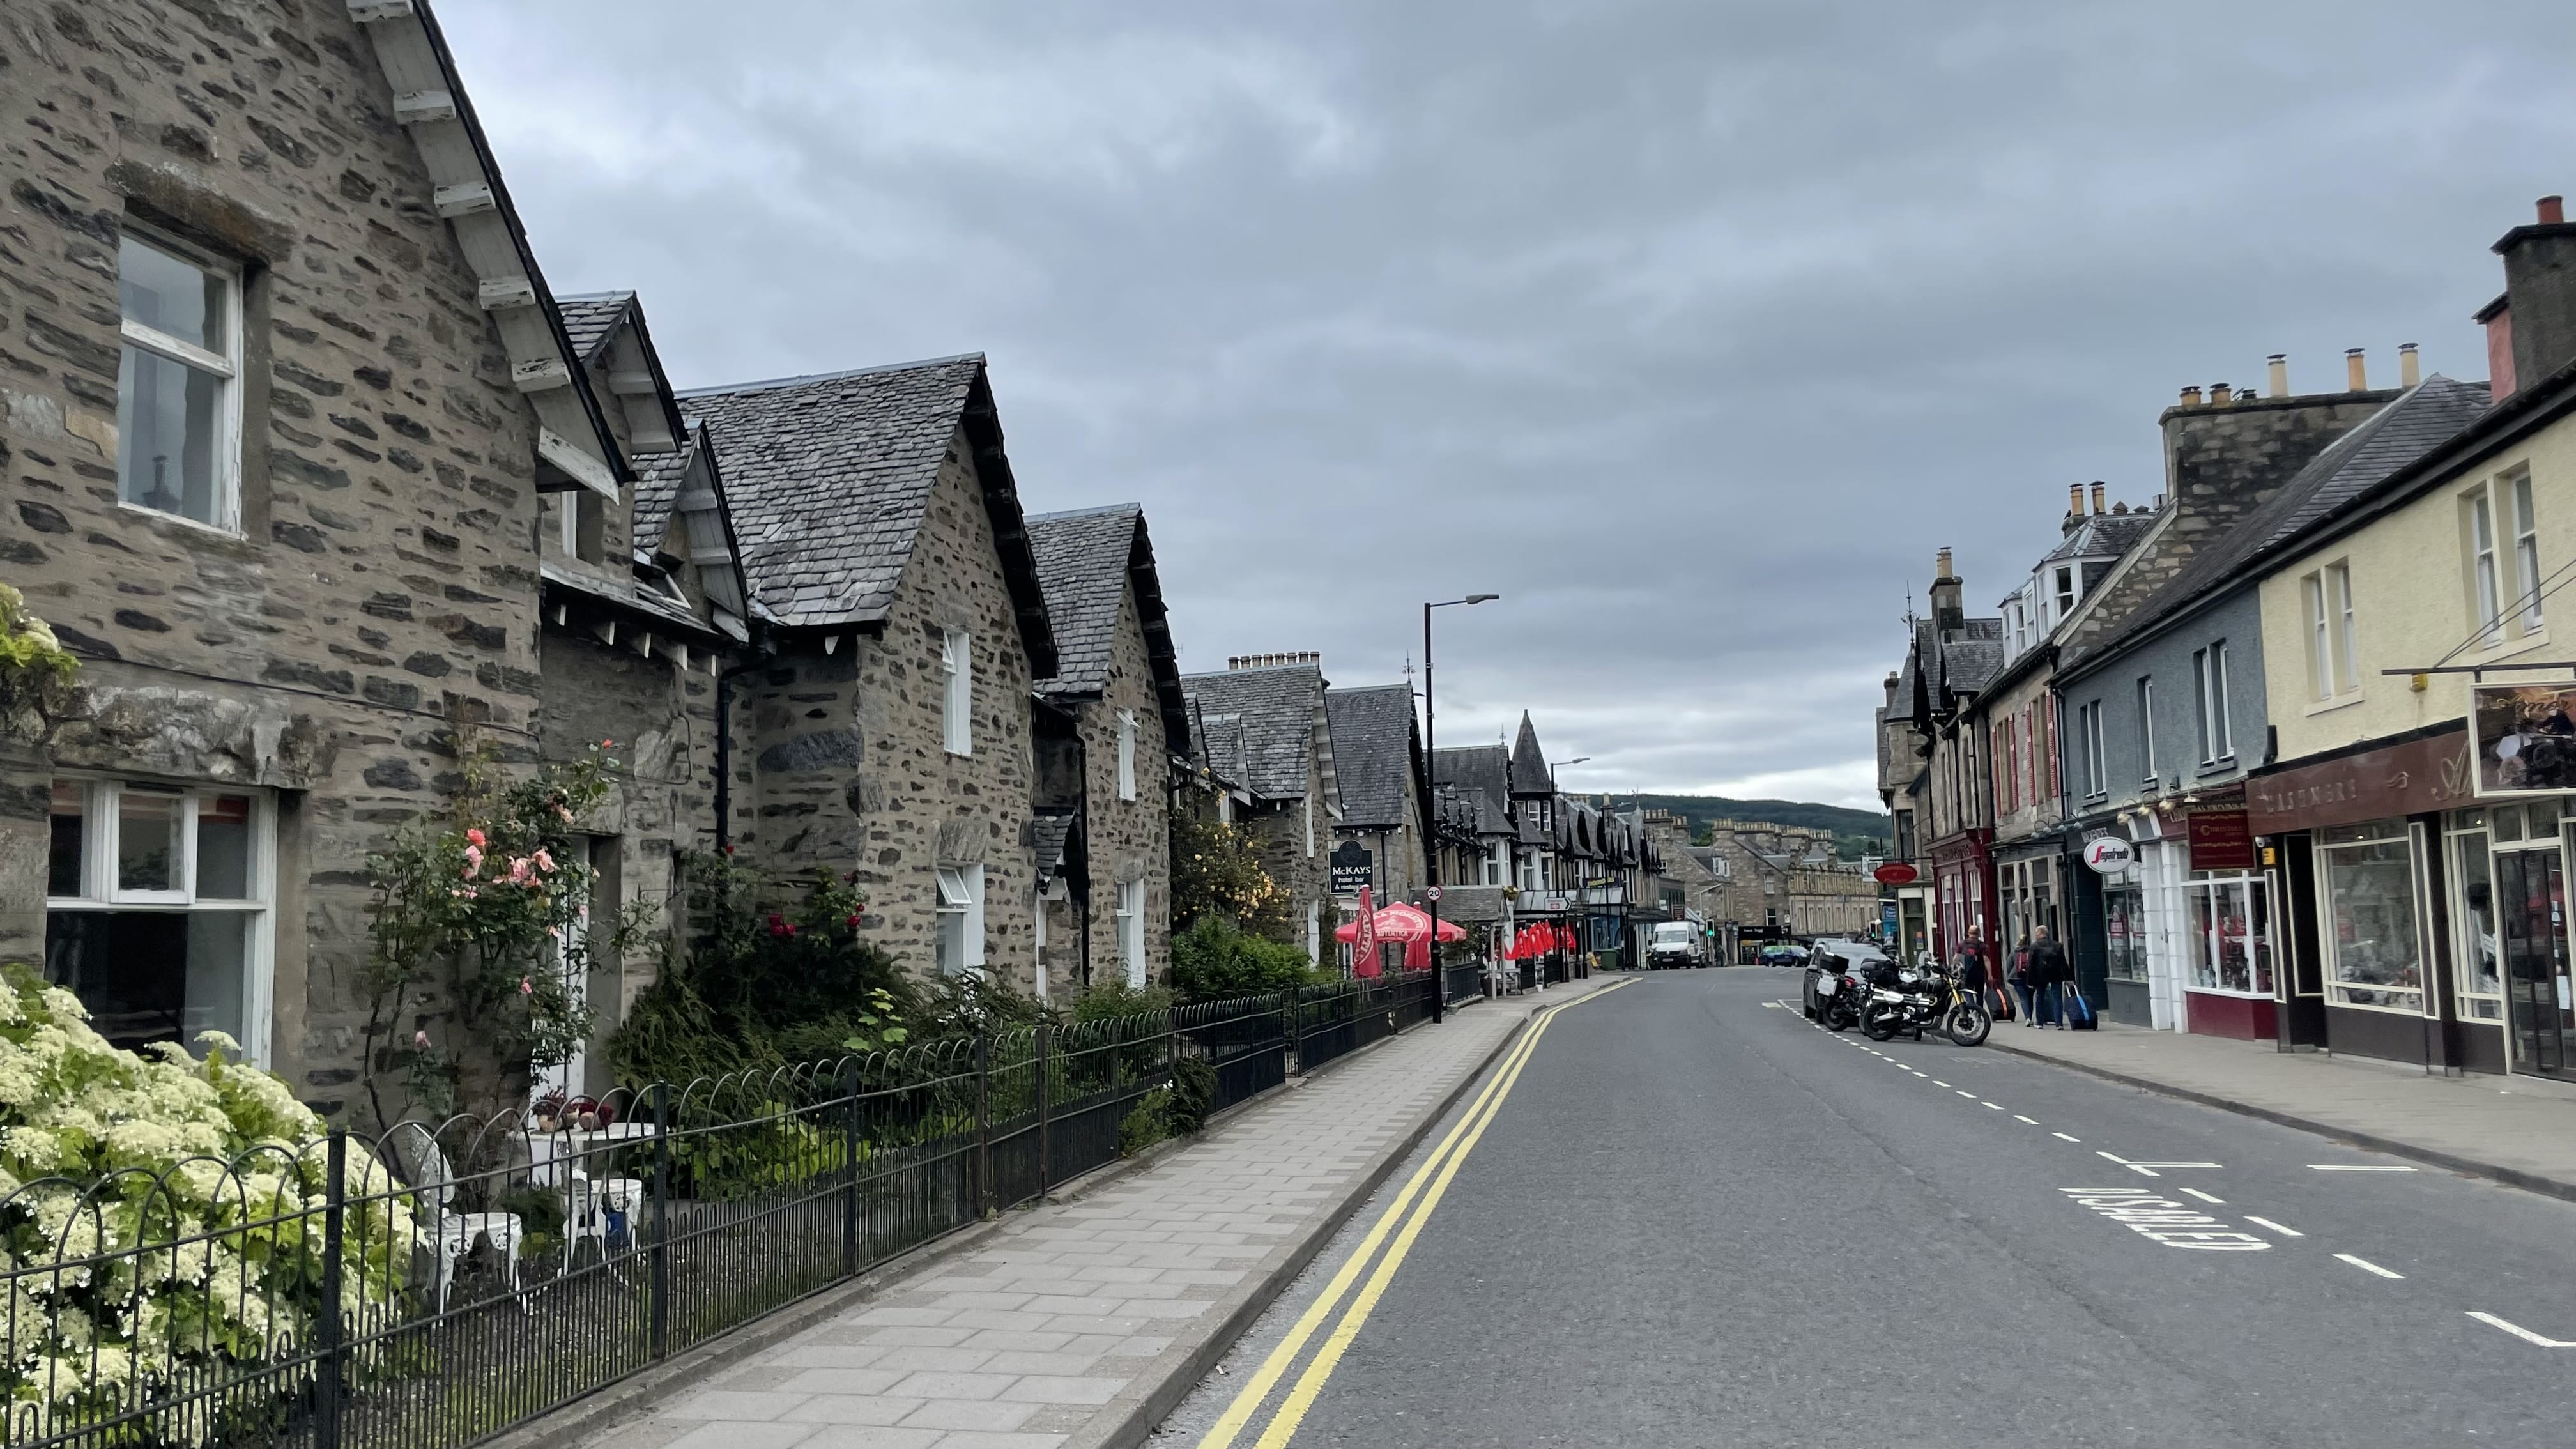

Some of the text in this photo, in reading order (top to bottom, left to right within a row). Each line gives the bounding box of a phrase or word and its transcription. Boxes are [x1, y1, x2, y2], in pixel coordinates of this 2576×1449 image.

[2091, 845, 2129, 864] Segafredo
[1332, 866, 1371, 875] McKAYS
[2058, 1188, 2273, 1251] DISABLED
